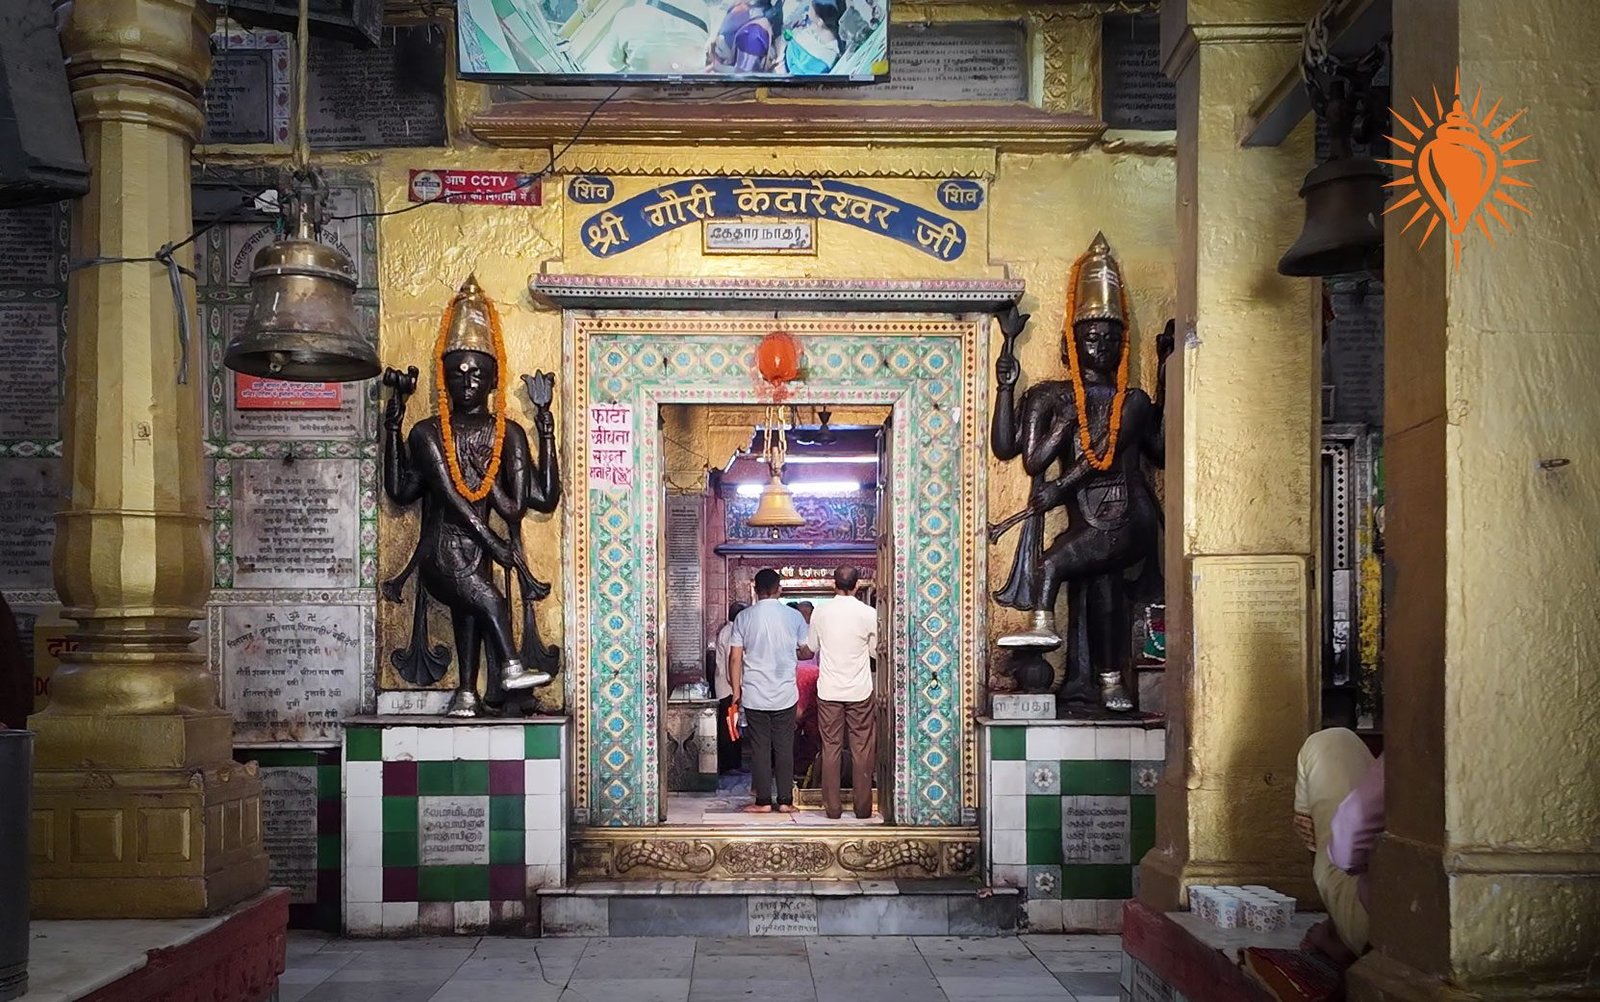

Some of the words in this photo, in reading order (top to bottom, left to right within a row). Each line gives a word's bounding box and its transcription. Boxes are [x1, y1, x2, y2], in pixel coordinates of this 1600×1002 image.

[471, 175, 508, 186] CCTV
[573, 180, 609, 200] शिव
[943, 182, 981, 204] शिव
[588, 214, 630, 254] श्री
[645, 184, 716, 227] गौरी
[734, 178, 900, 230] केदारेश्वर
[915, 216, 963, 258] जी
